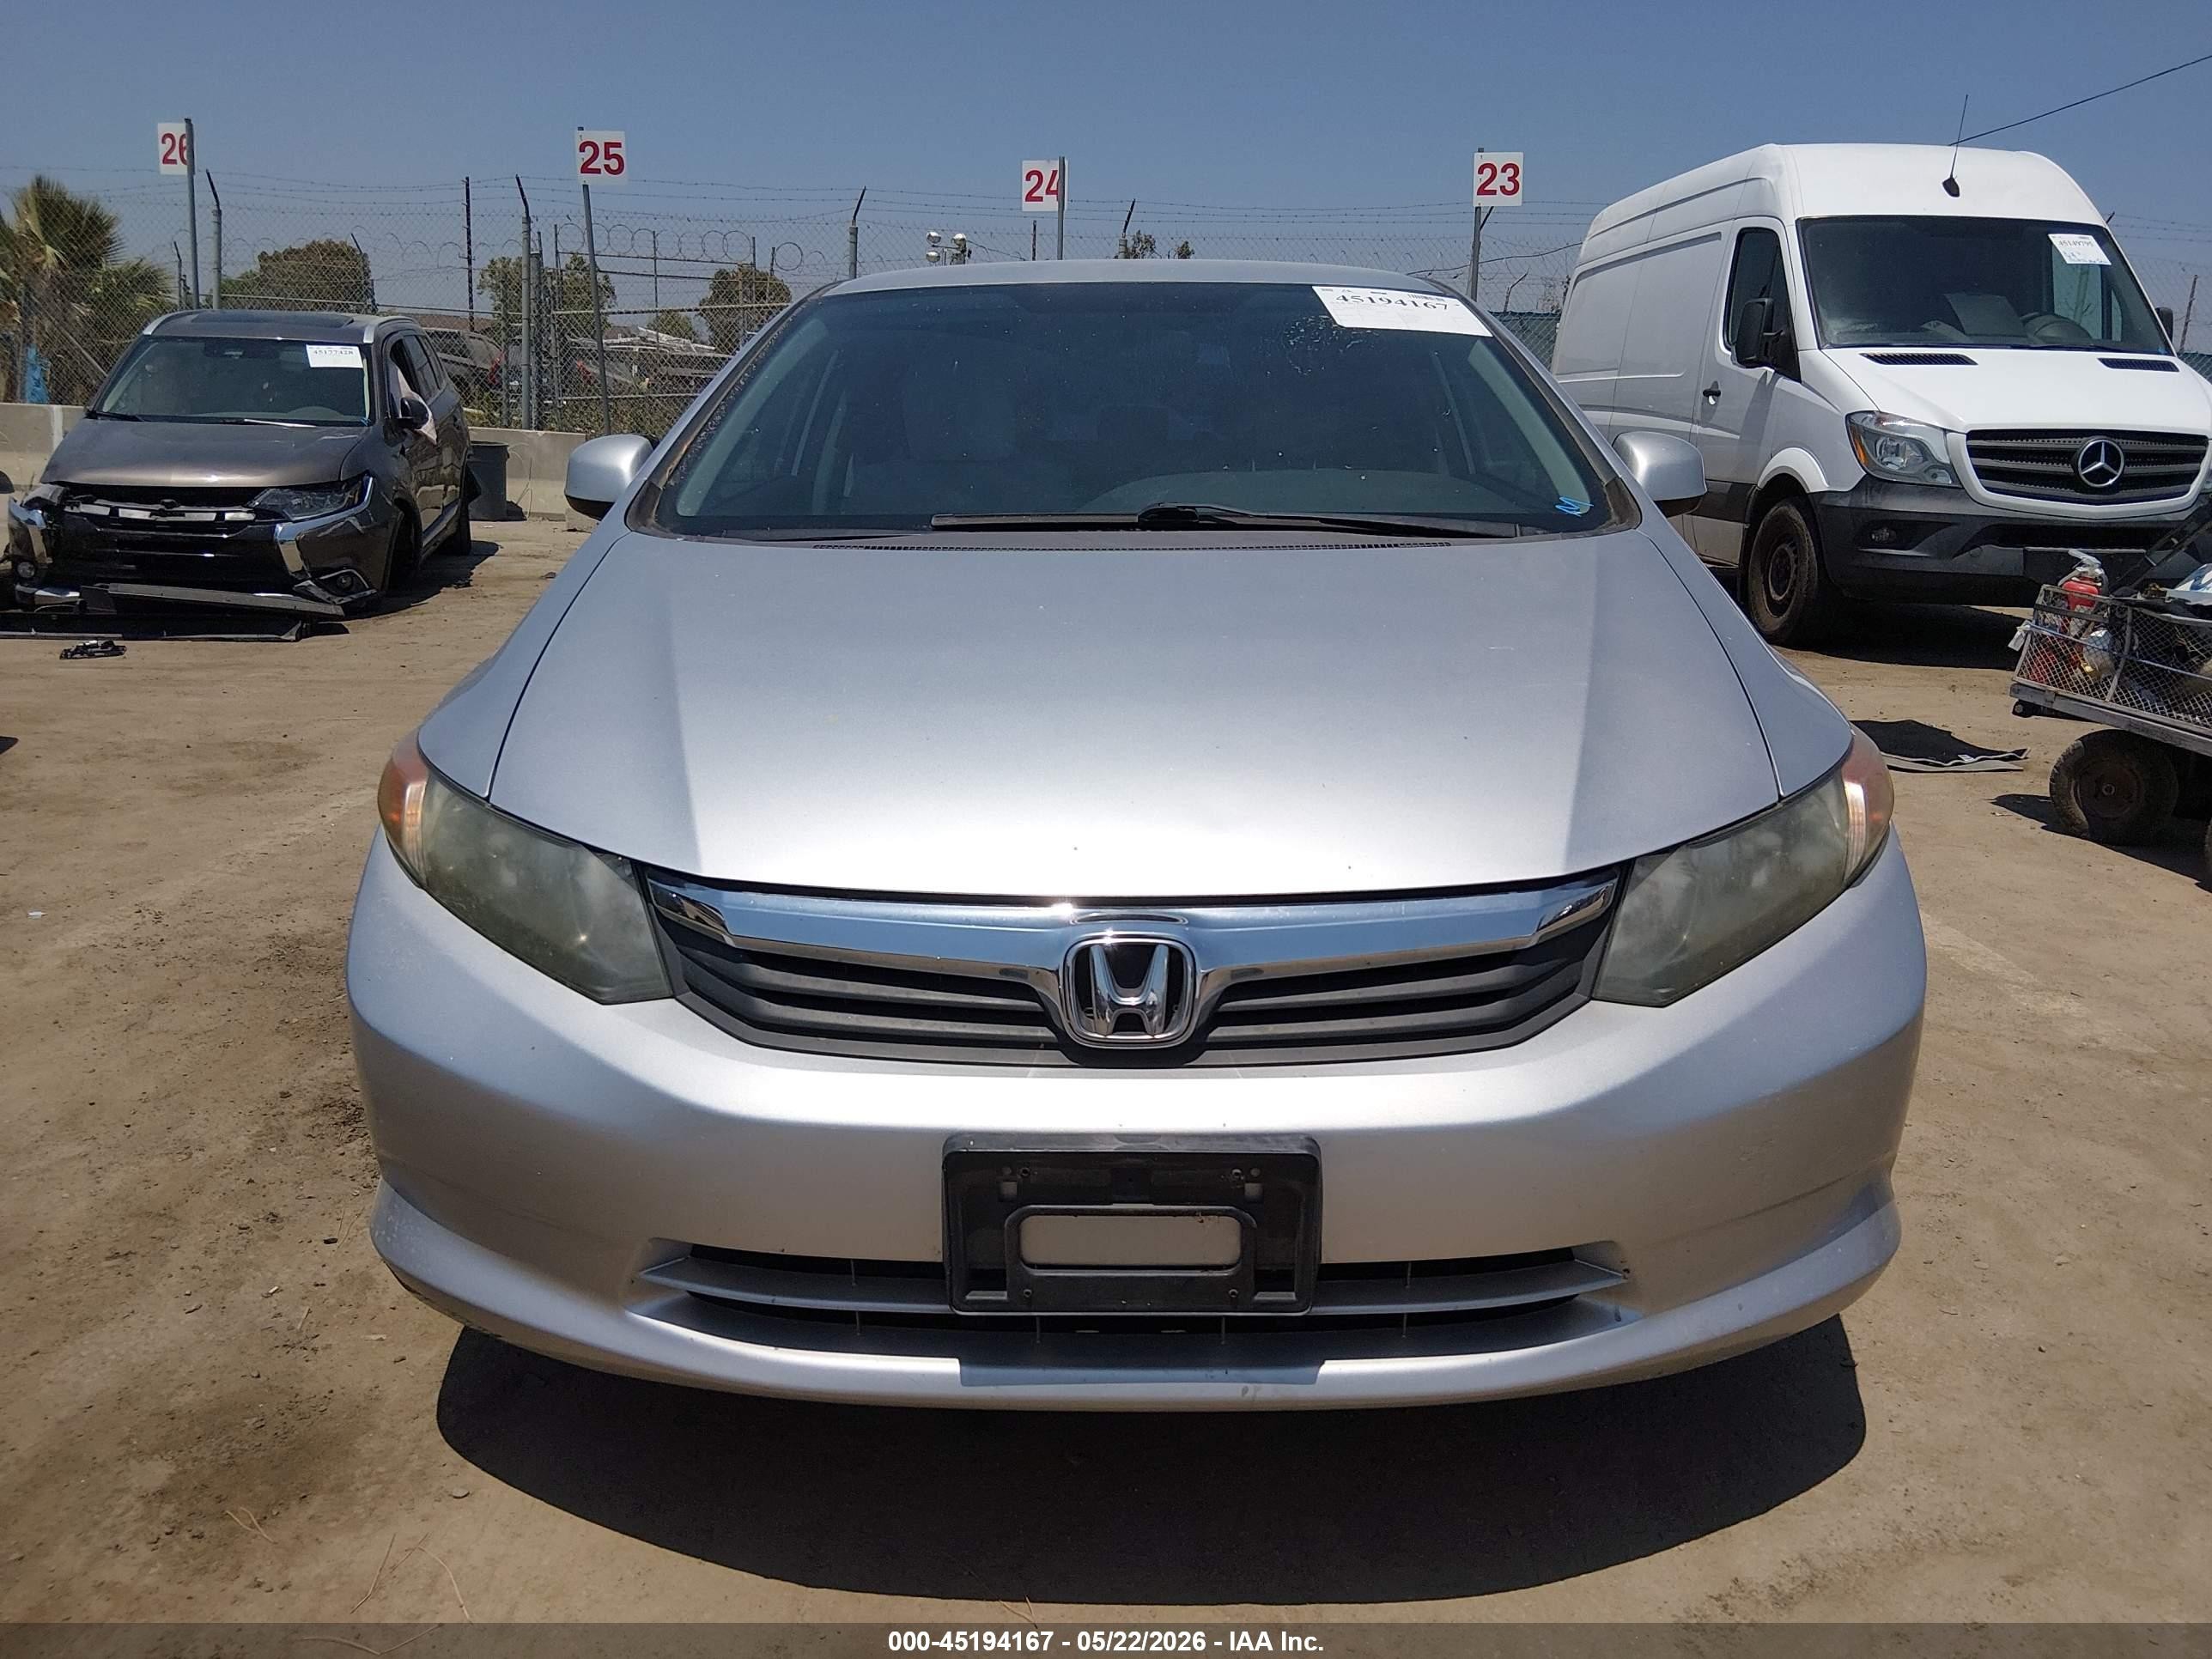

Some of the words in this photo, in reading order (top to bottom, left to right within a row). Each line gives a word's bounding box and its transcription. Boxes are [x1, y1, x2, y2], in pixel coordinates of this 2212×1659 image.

[579, 140, 625, 175] 25
[1024, 169, 1059, 203] 24
[1476, 162, 1520, 196] 23
[1336, 295, 1449, 310] 45194167
